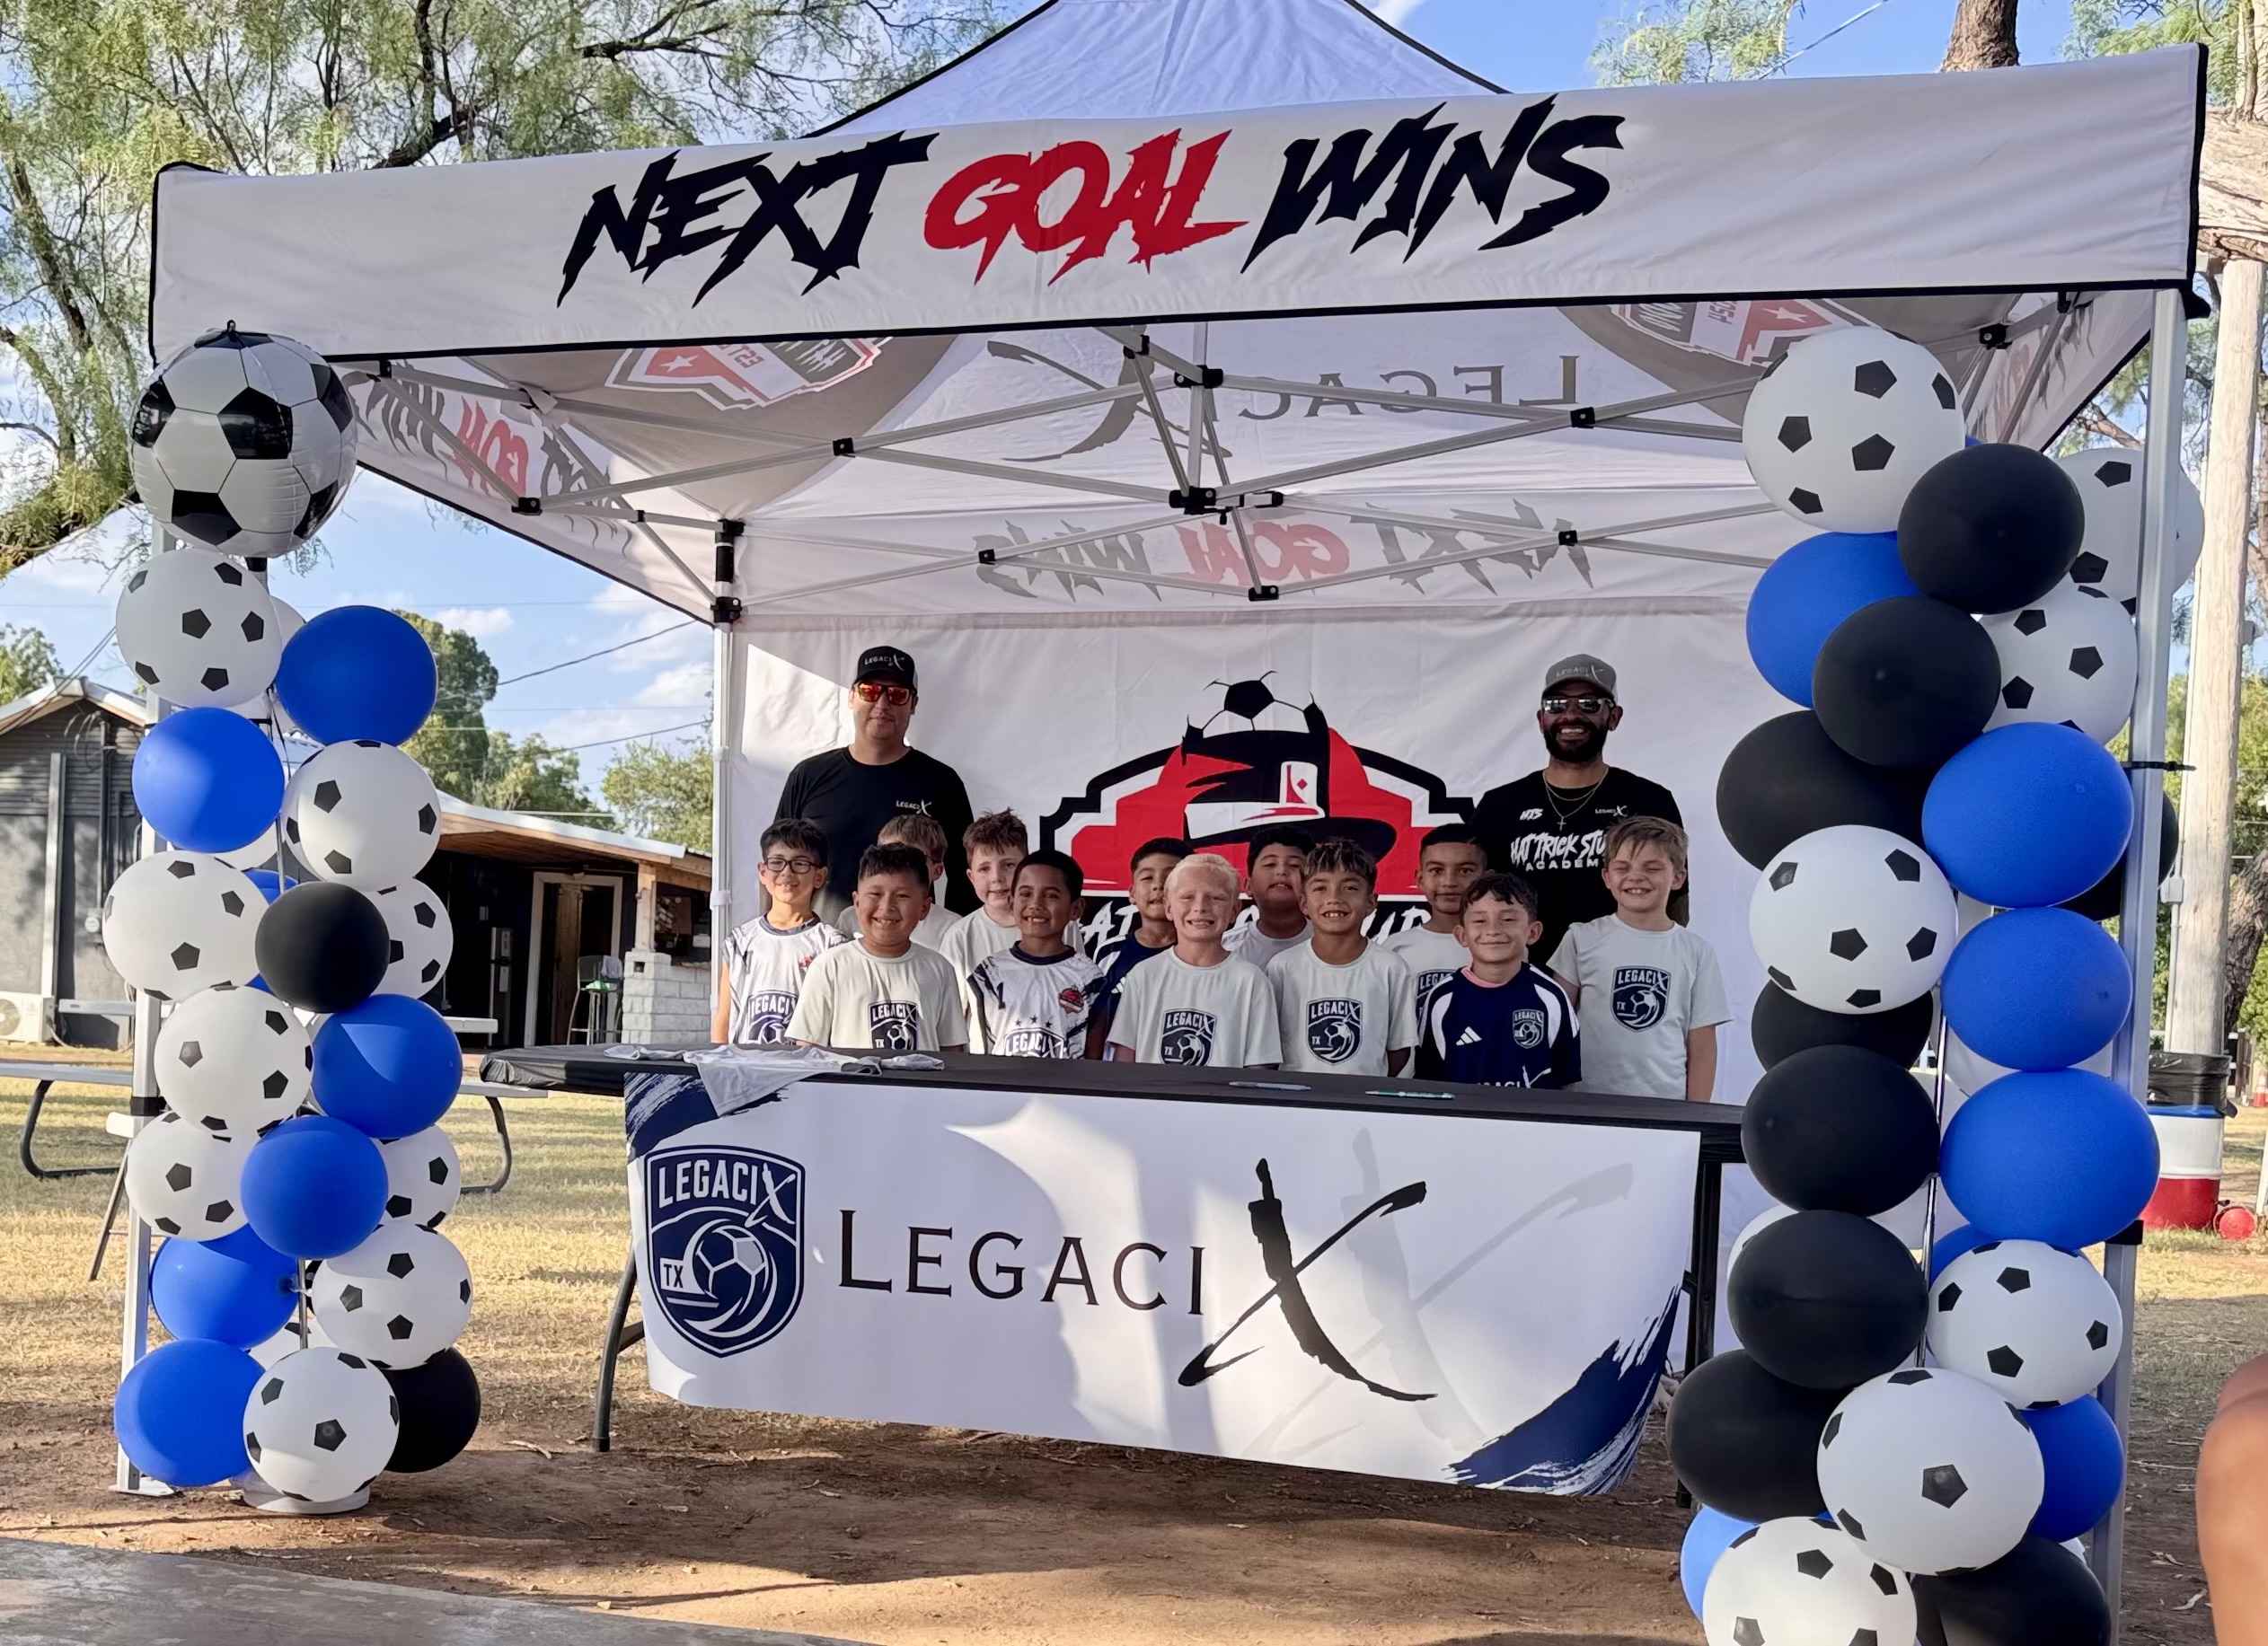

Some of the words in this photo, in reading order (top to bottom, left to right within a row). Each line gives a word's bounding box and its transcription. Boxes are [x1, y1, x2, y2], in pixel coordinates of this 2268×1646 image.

[557, 132, 939, 308] NEXT
[924, 128, 1250, 286] GOAL
[1241, 96, 1626, 274] WINS
[1533, 831, 1580, 863] TRICK
[1525, 858, 1600, 872] ACADEM
[663, 1263, 684, 1290] TX
